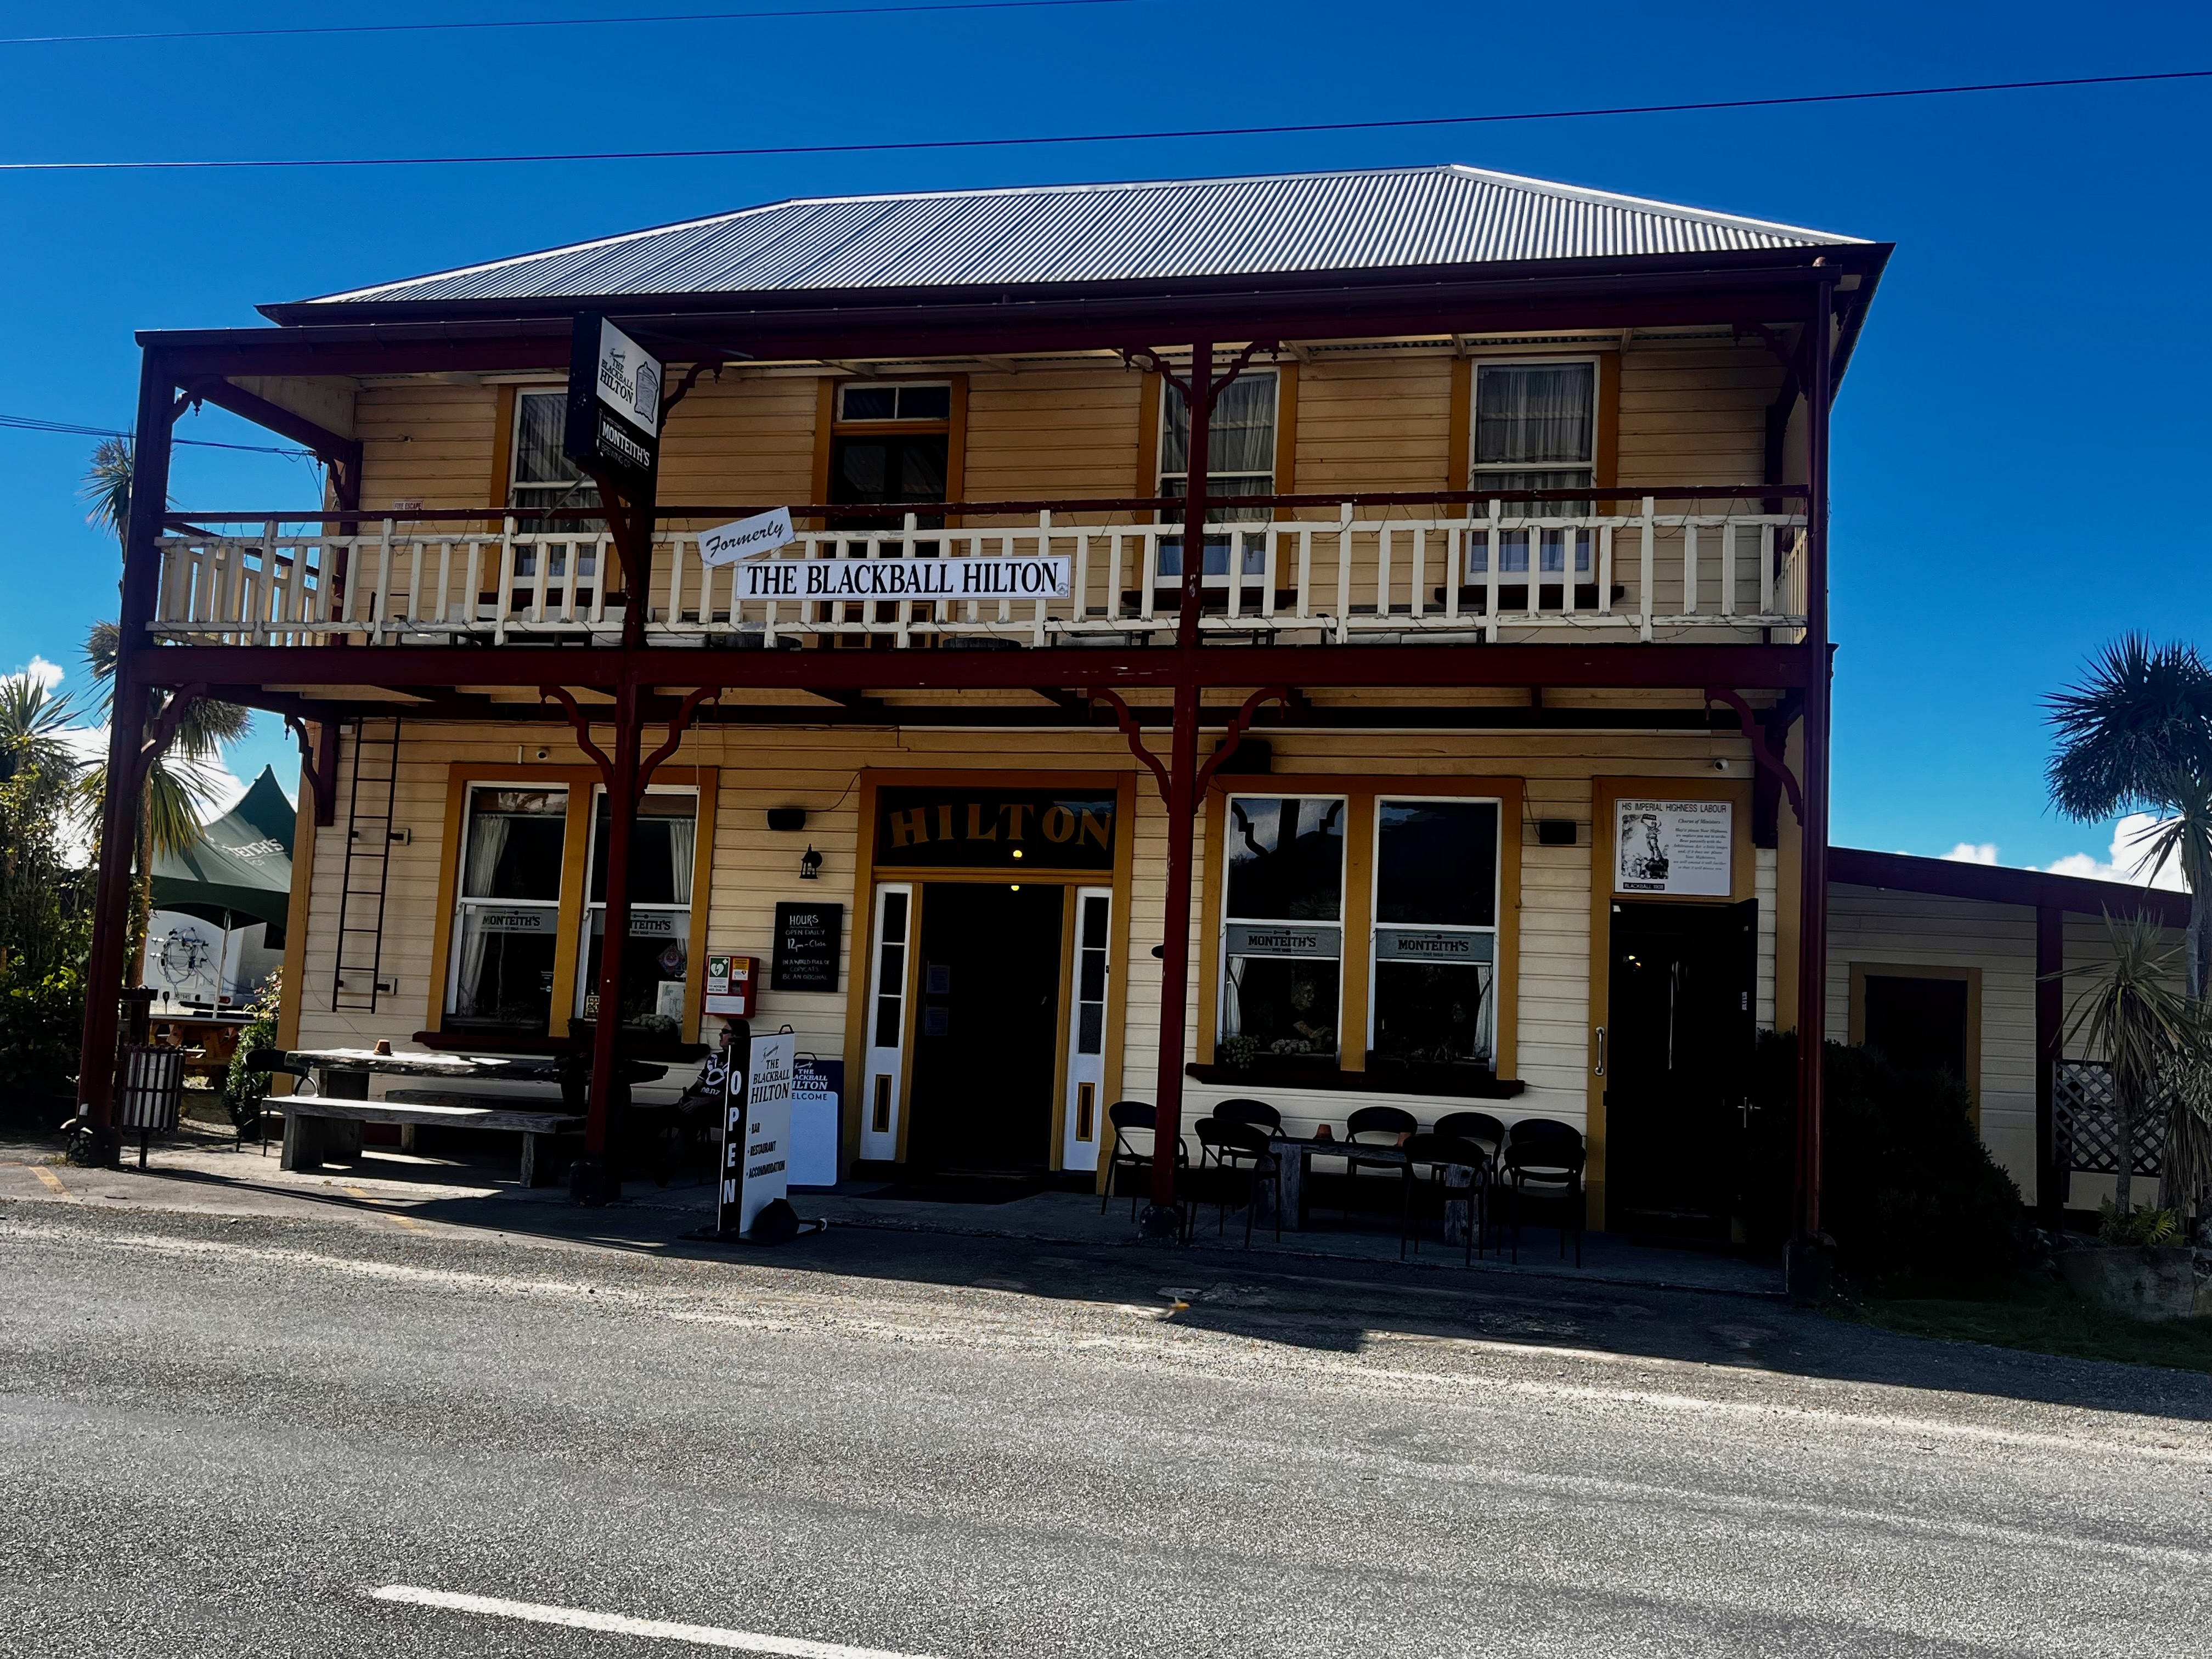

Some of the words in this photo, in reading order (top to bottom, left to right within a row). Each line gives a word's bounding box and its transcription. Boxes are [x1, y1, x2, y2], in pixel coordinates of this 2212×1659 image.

[613, 358, 624, 373] THE
[601, 359, 633, 391] BLACKBALL
[600, 368, 634, 404] HILTON
[602, 421, 650, 467] MONTEITH'S
[706, 520, 785, 558] Formerly
[747, 565, 798, 595] THE
[805, 563, 954, 594] BLACKBALL
[962, 562, 1058, 594] HILTON
[1622, 802, 1632, 811] HIS
[1634, 803, 1663, 811] IMPERIAL
[1666, 803, 1698, 812] HIGHNESS
[1700, 804, 1726, 813] LABOUR
[888, 803, 1113, 852] HILTON
[482, 916, 541, 927] MONTEITH'S
[630, 919, 671, 930] TEITH'S
[789, 915, 819, 927] HOURS
[1248, 935, 1316, 947] MONTEITH'S
[1398, 940, 1469, 952] MONTEITH'S
[766, 1058, 780, 1070] THE
[753, 1069, 790, 1085] BLACKBALL
[750, 1082, 790, 1104] HILTON
[792, 1081, 828, 1090] ILTON
[792, 1092, 828, 1101] ELCOME
[751, 1122, 760, 1134] BAR
[723, 1070, 742, 1204] OPEN
[750, 1141, 776, 1156] RESTAURANT
